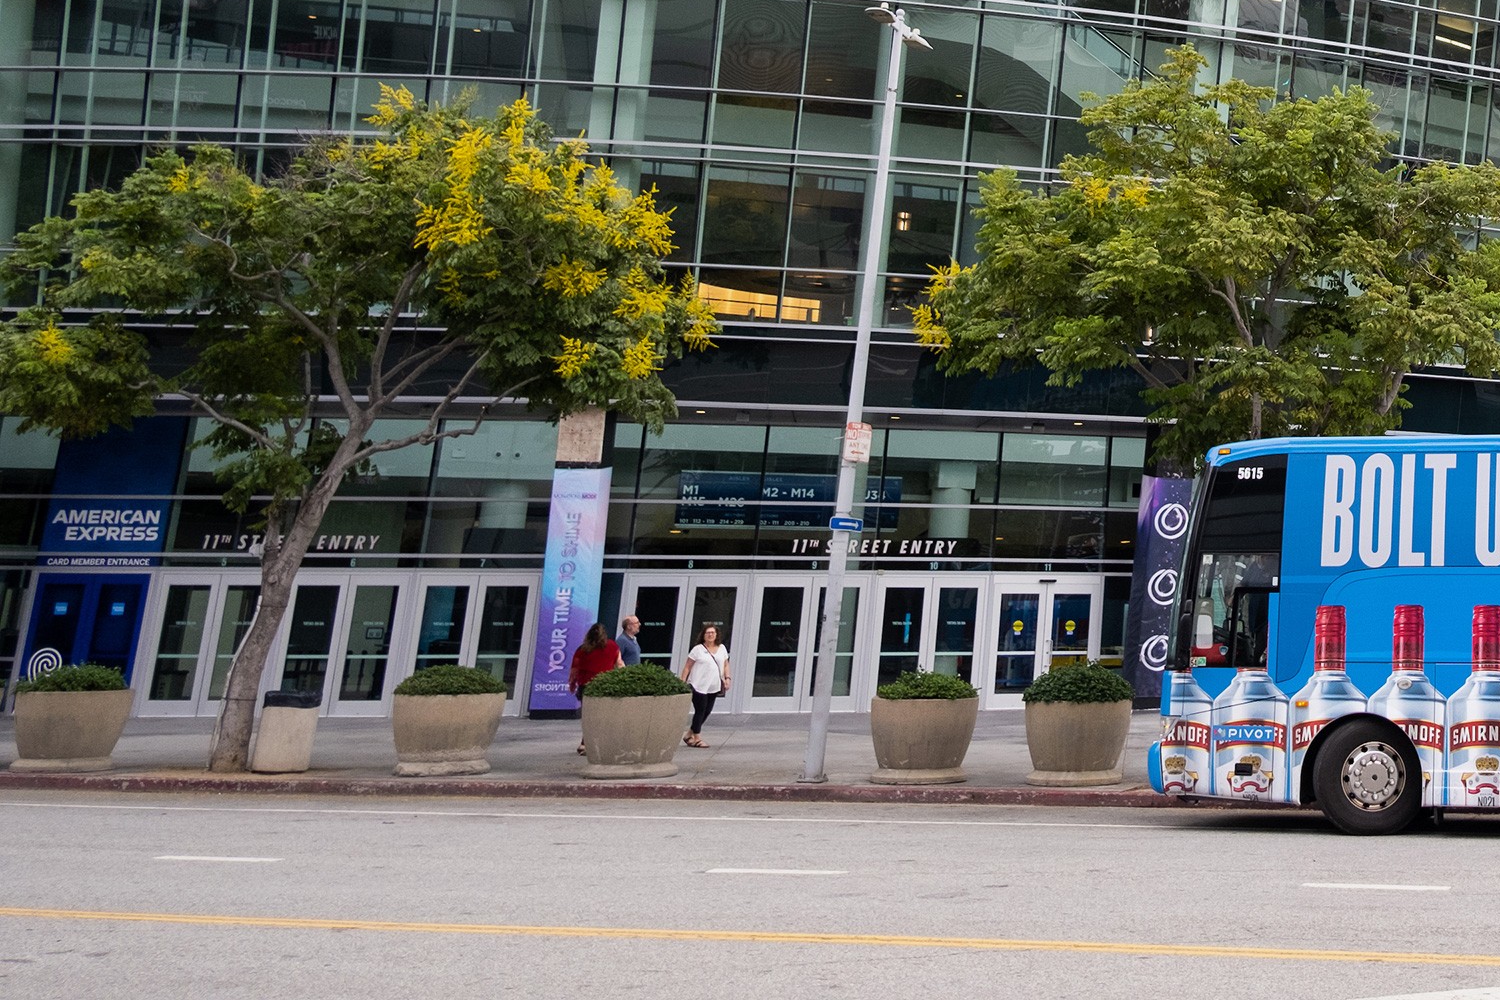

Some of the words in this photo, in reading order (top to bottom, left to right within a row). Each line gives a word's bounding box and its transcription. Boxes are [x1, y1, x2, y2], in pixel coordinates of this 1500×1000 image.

[847, 429, 858, 440] NO
[1237, 467, 1264, 480] 5615
[682, 485, 699, 495] M1
[762, 487, 779, 498] M2
[791, 488, 815, 498] M14
[1320, 453, 1457, 567] BOLT
[52, 509, 161, 524] AMERICAN
[65, 526, 159, 541] EXPRESS
[560, 512, 582, 557] SHINE
[202, 534, 232, 550] 11TH
[316, 535, 380, 550] ENTRY
[791, 538, 819, 554] 11TH
[825, 539, 892, 554] SREET
[899, 540, 958, 555] ENTRY
[47, 558, 70, 566] CARD
[71, 558, 106, 566] MEMBER
[107, 558, 150, 566] ENTRANCE
[220, 558, 227, 567] 5
[350, 558, 357, 568] 6
[479, 558, 486, 567] 7
[687, 560, 694, 569] 8
[811, 560, 818, 570] 9
[929, 562, 939, 571] 10
[1044, 563, 1052, 572] 11
[558, 560, 577, 583] TO
[553, 587, 572, 624] TIME
[548, 628, 568, 673] YOUR
[535, 683, 579, 692] SHOWTI
[1167, 725, 1209, 745] RNOFF
[1228, 728, 1273, 739] PIVOT
